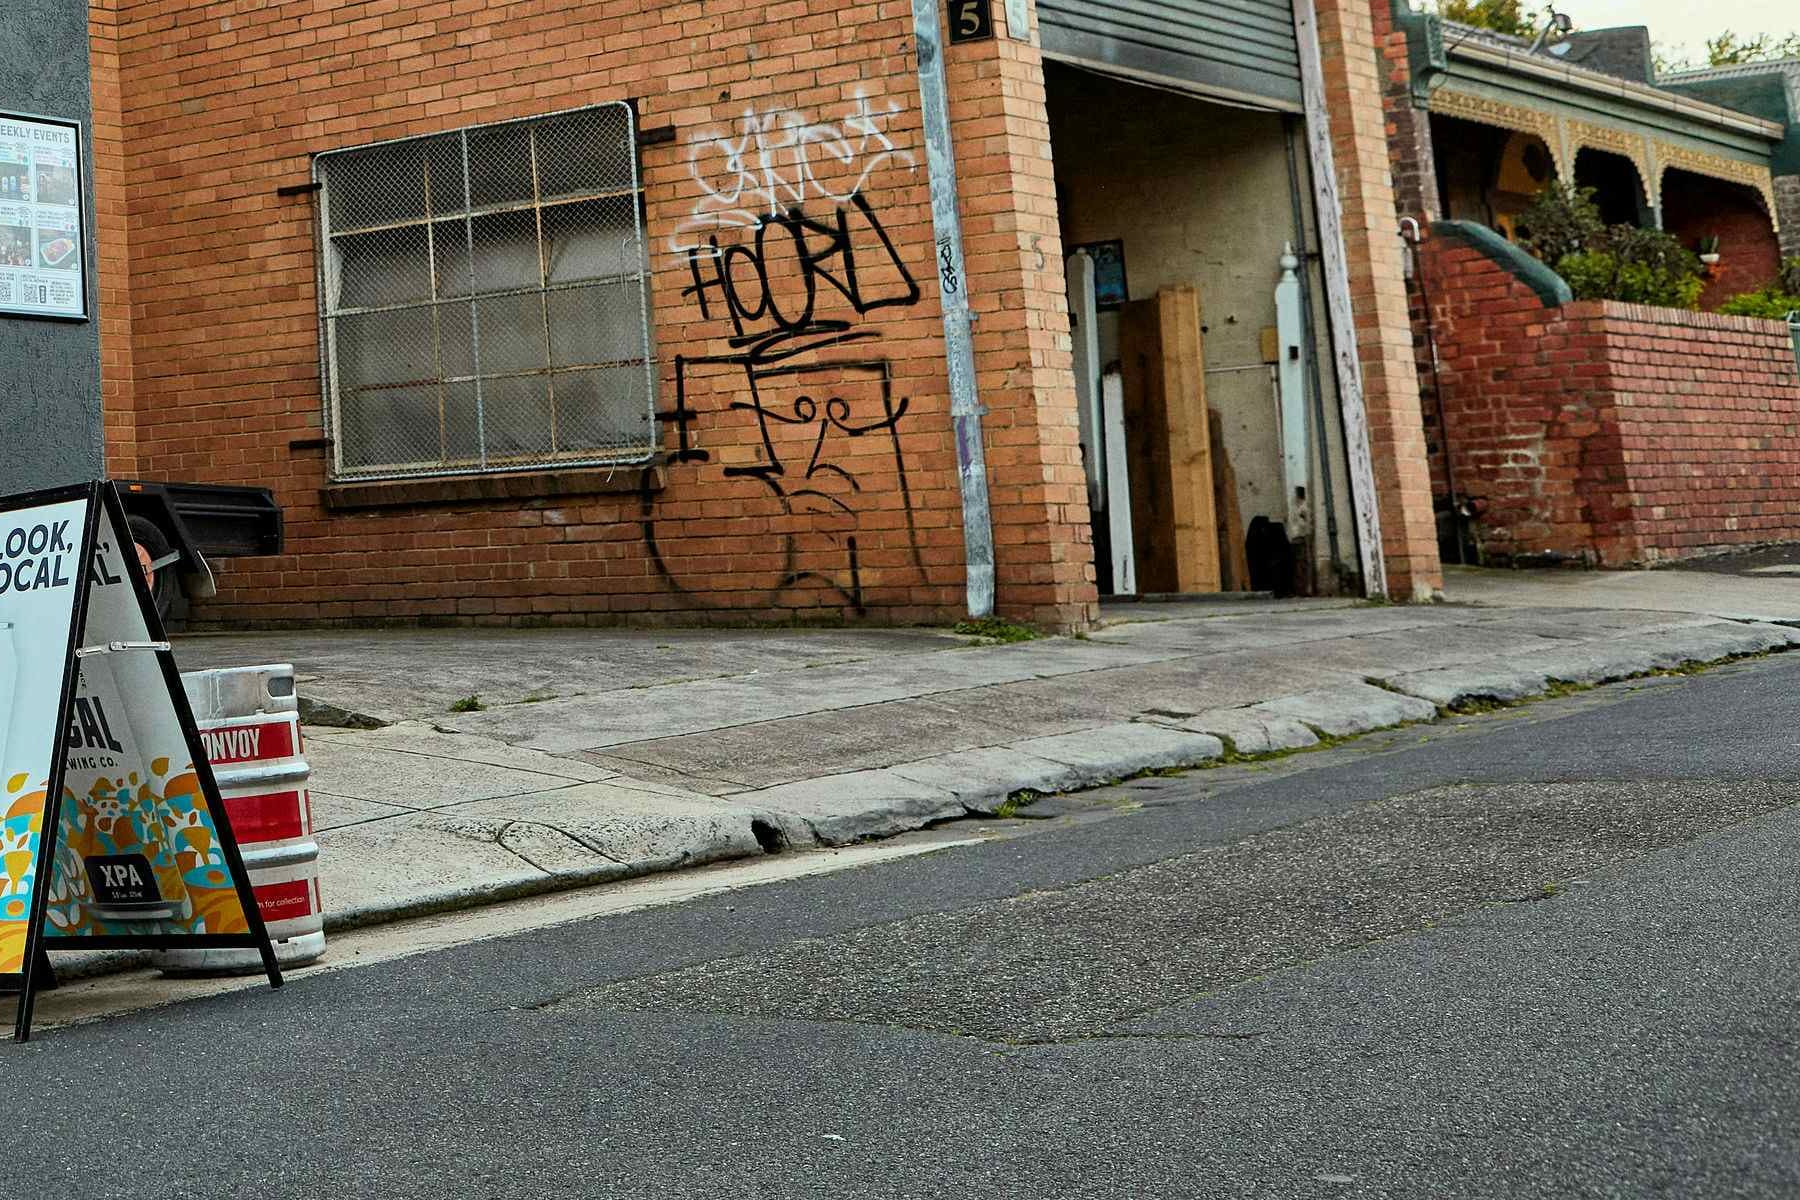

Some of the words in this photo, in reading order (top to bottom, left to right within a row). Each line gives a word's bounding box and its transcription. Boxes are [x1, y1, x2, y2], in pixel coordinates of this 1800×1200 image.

[960, 2, 979, 35] 5
[33, 128, 70, 144] EVENTS
[200, 728, 260, 761] ONVOY
[67, 756, 97, 770] WING
[100, 756, 118, 768] CO.
[99, 864, 144, 887] XPA
